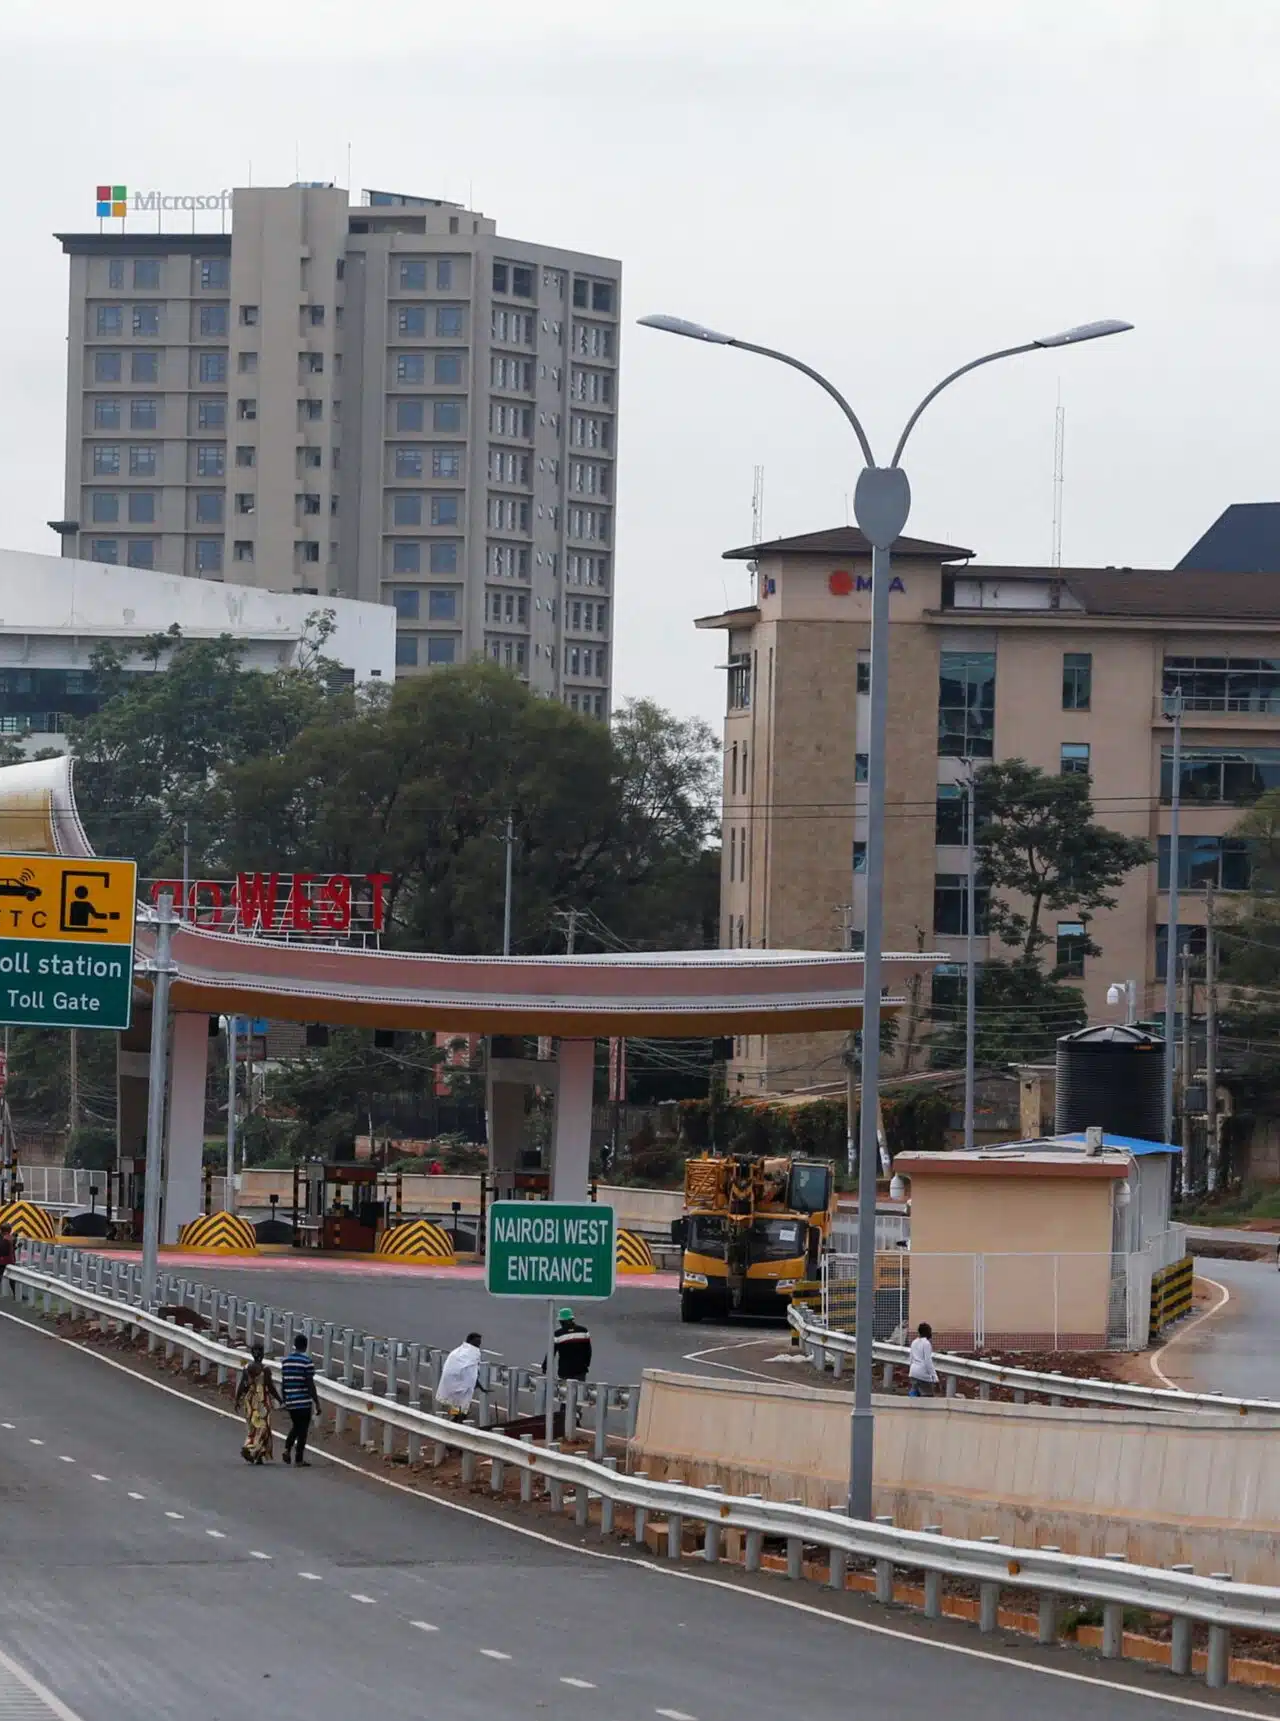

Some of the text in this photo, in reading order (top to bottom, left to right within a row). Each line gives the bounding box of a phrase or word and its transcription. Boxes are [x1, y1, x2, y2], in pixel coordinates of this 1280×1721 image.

[856, 576, 905, 593] MA
[236, 872, 391, 931] WEST
[37, 954, 122, 978] station
[7, 989, 101, 1011] Toll Gate
[494, 1217, 609, 1246] NAIROBI WEST
[507, 1255, 593, 1283] ENTRANCE
